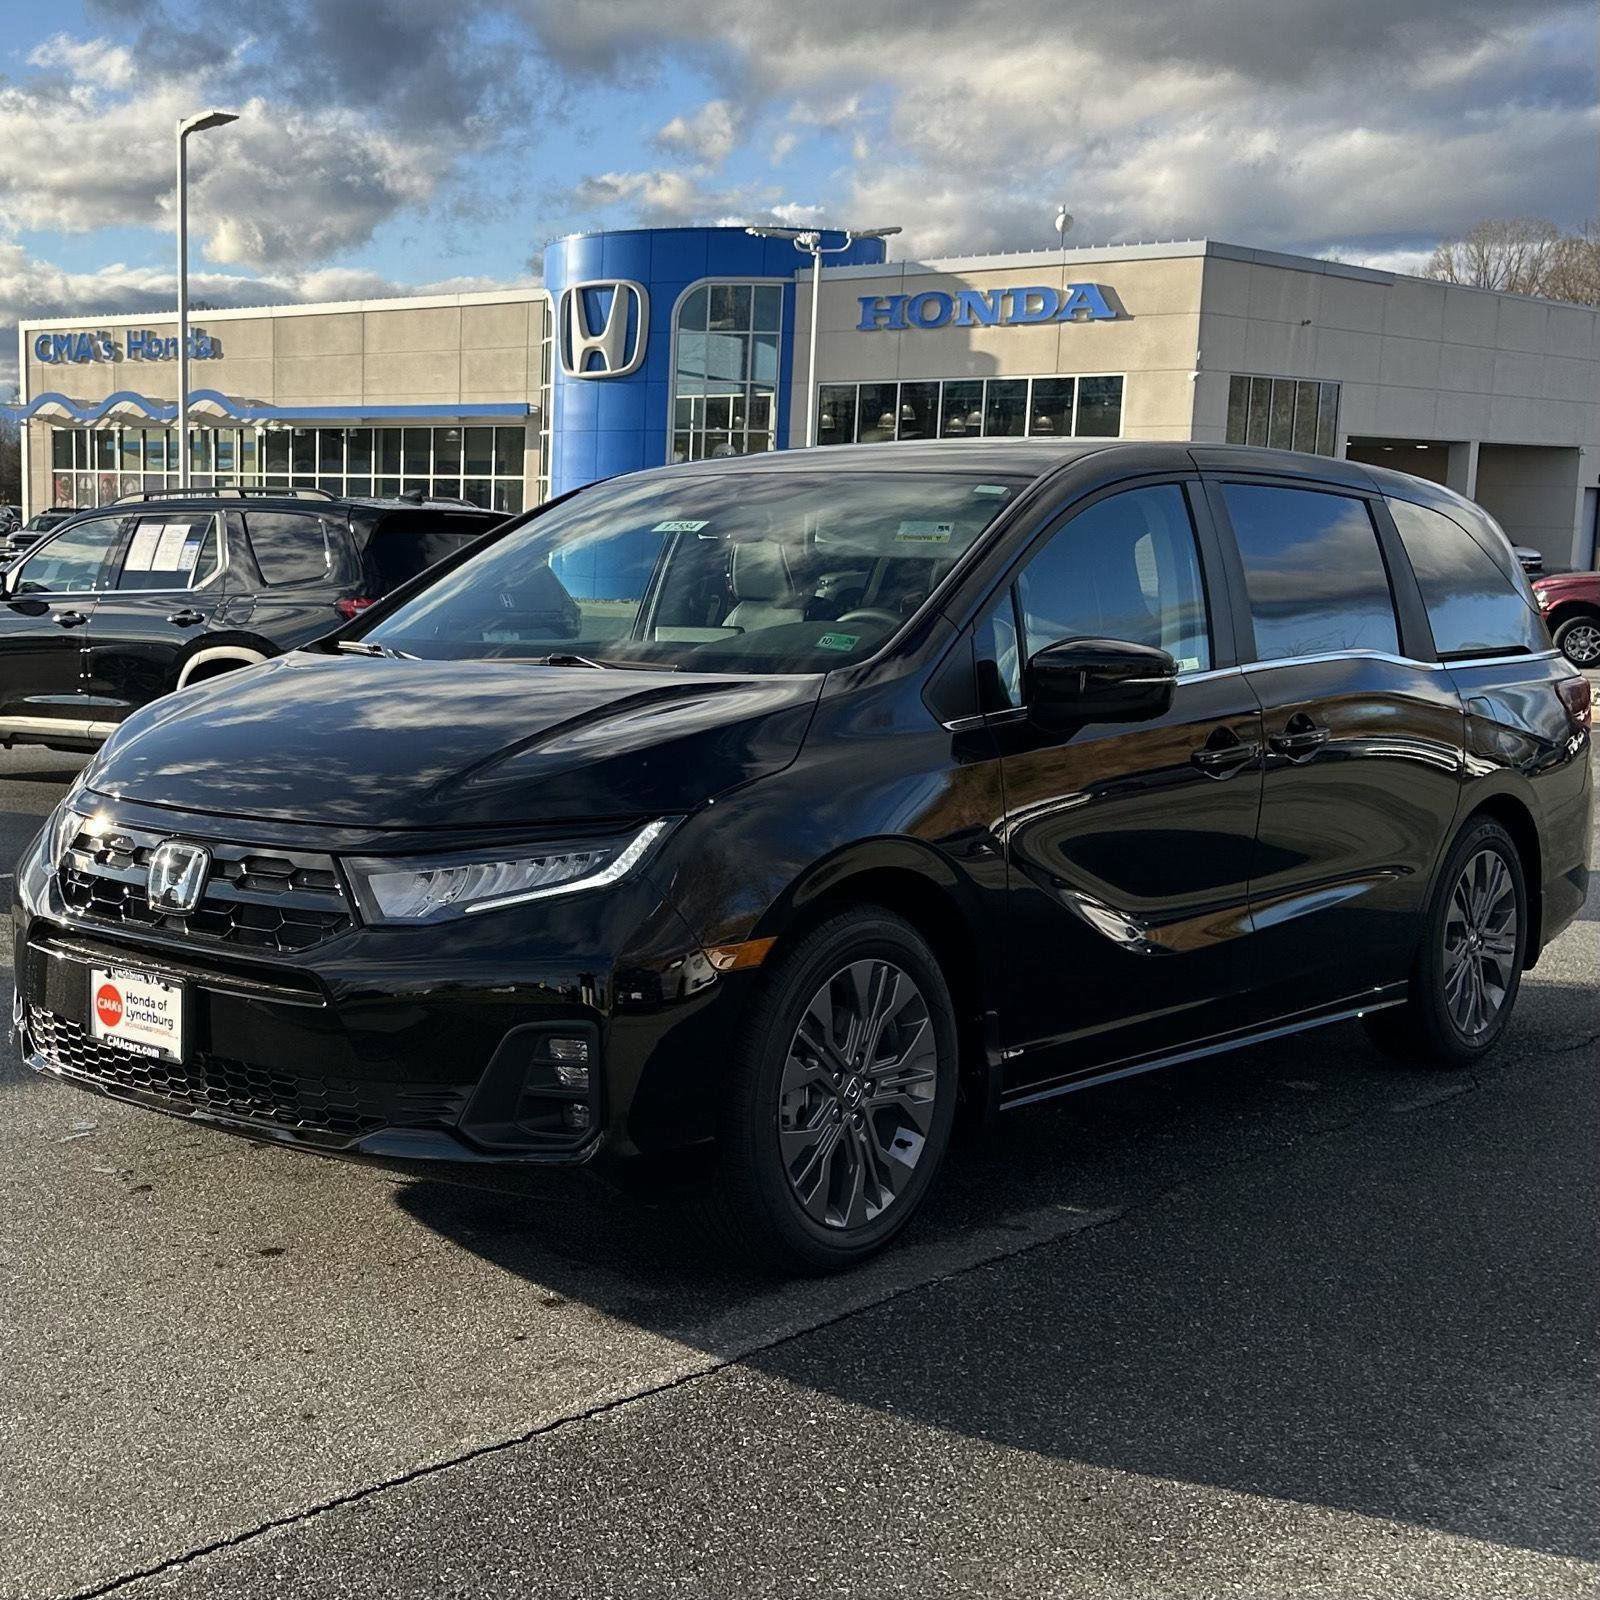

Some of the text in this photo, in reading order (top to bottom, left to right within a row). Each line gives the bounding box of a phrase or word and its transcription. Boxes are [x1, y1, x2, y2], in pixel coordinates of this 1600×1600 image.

[856, 283, 1117, 331] HONDA
[35, 330, 115, 363] CMA's
[126, 991, 168, 1011] Honda of
[126, 1006, 174, 1031] Lynchburg
[106, 1035, 160, 1059] CMAcars.com
